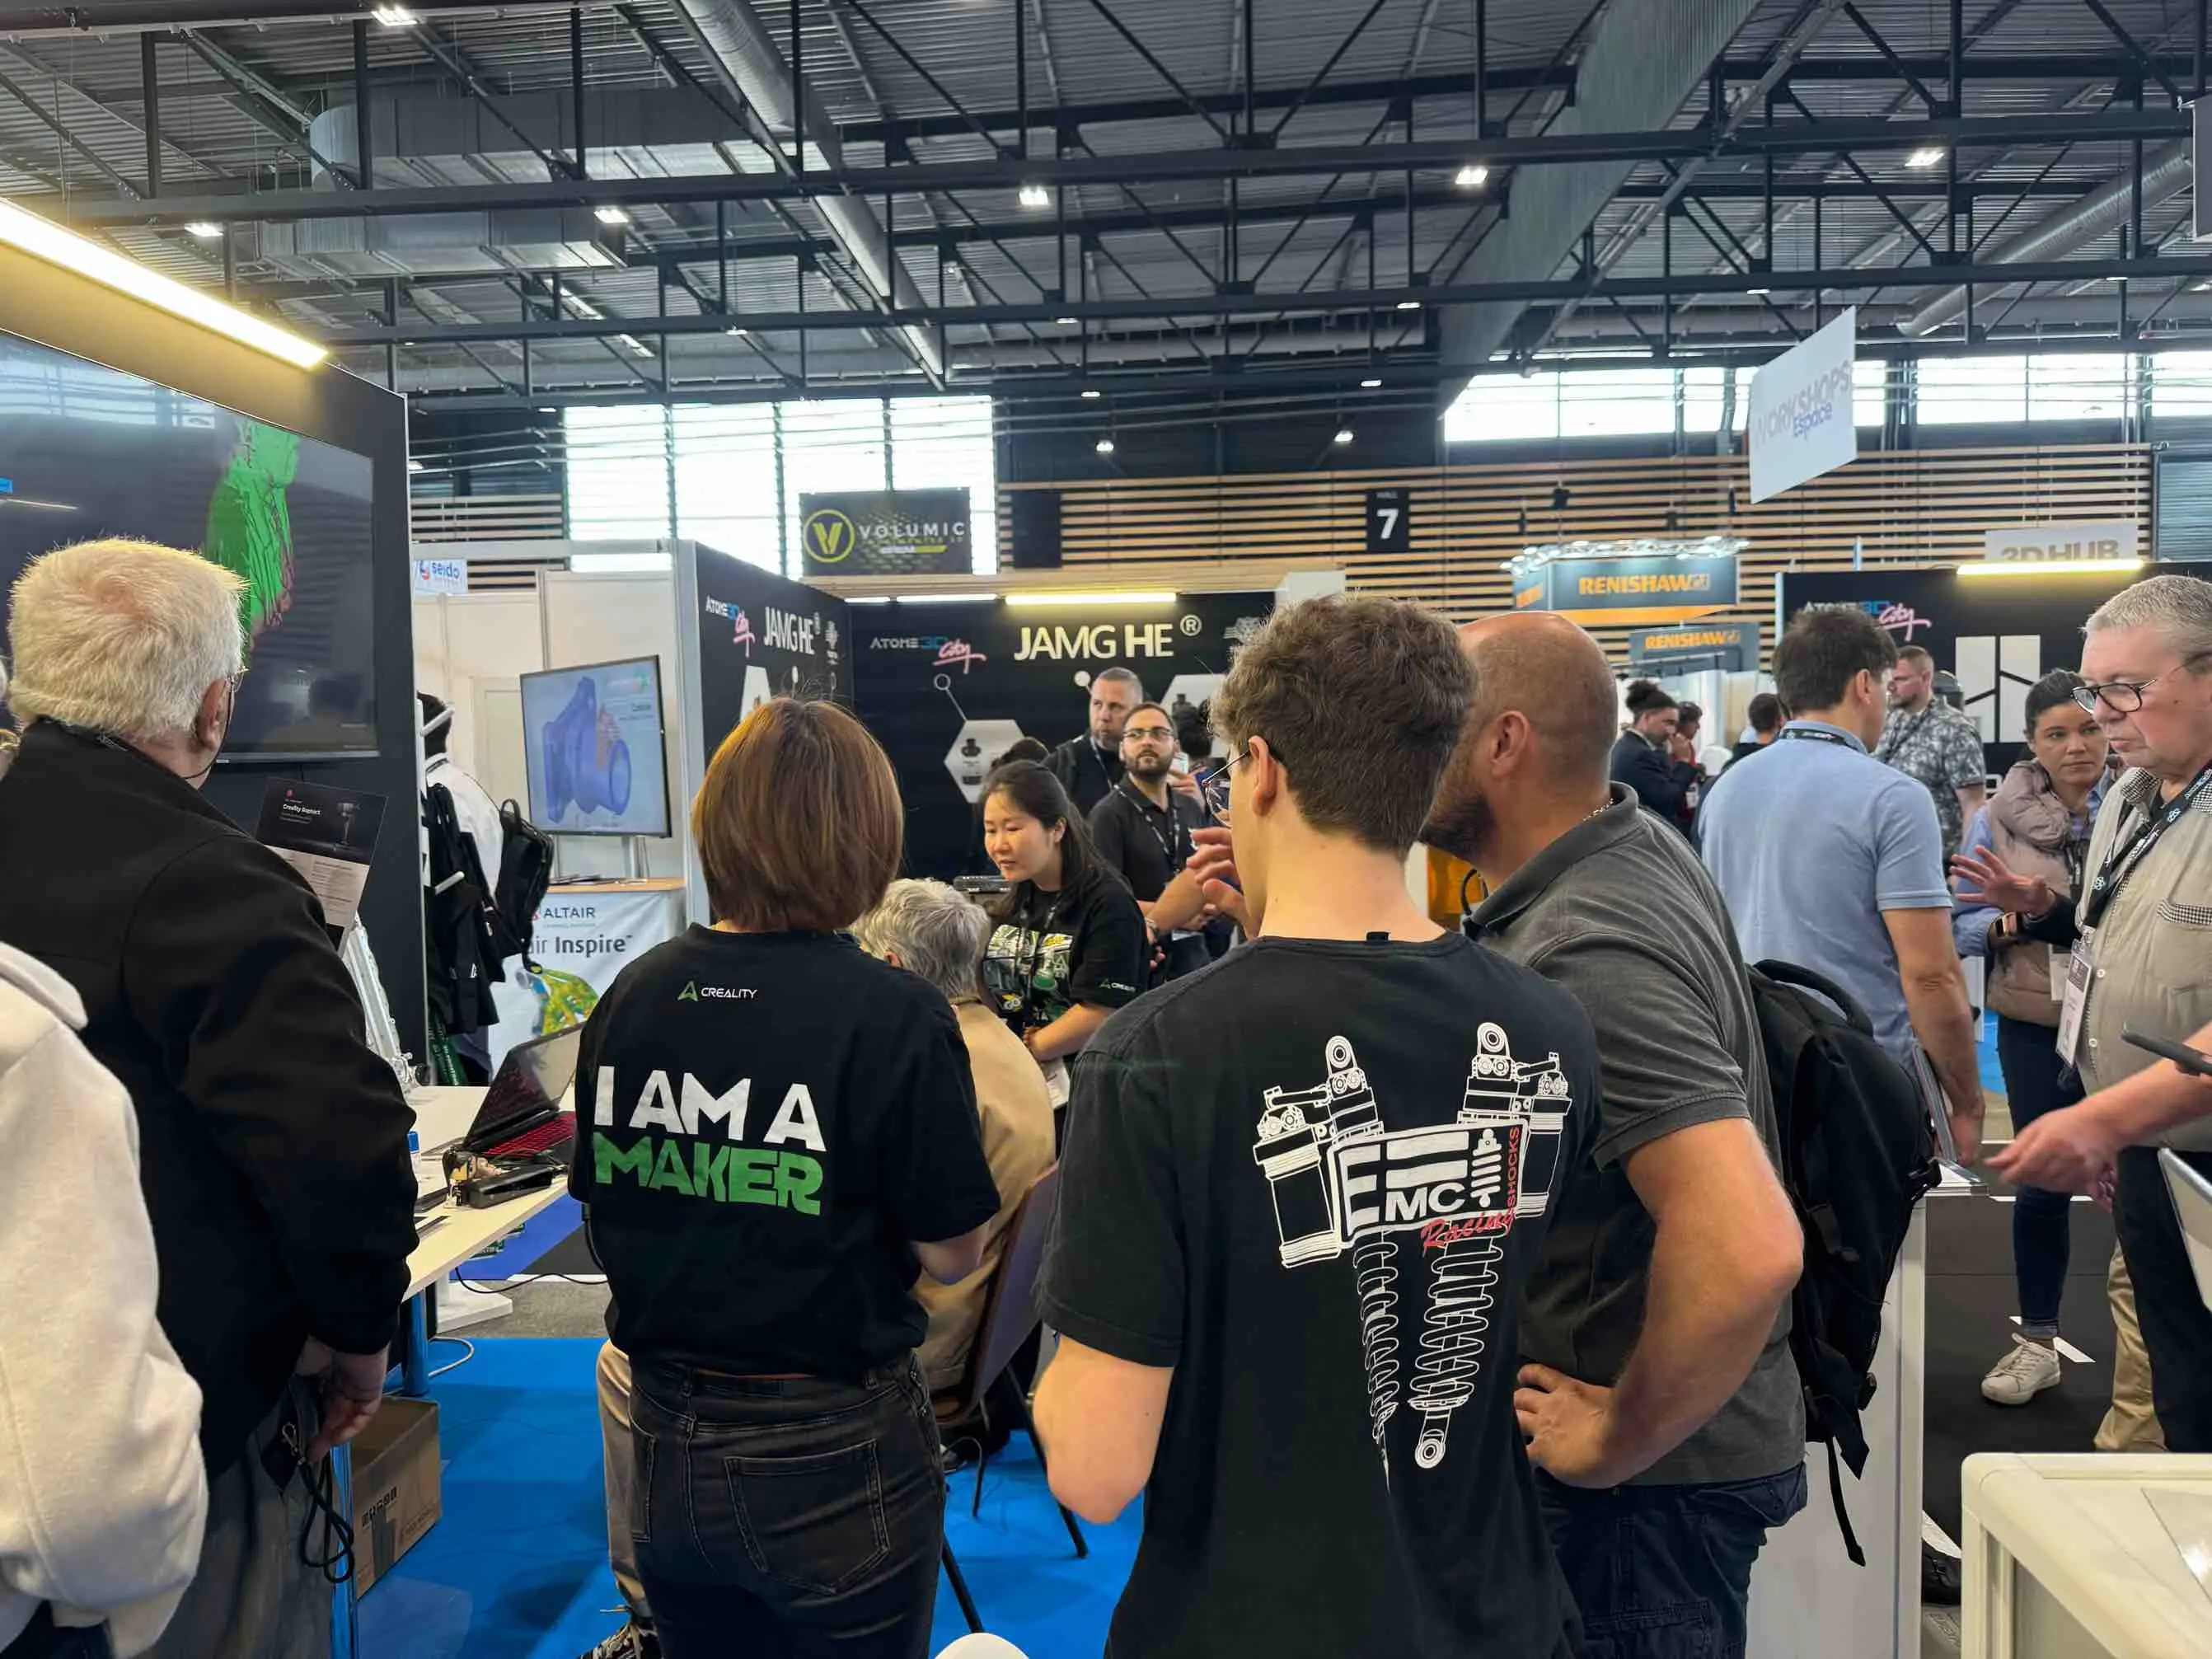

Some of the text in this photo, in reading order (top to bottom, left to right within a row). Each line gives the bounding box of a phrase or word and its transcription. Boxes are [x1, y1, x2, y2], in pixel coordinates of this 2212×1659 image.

[1752, 359, 1849, 448] WORKSHOPS
[1794, 402, 1832, 439] Espace
[859, 522, 964, 538] VOLUMIC
[1376, 508, 1399, 540] 7
[1578, 574, 1692, 595] RENISHAW
[1645, 631, 1725, 650] RENISHAW
[543, 907, 595, 919] ALTAIR
[701, 987, 757, 999] CREALITY
[594, 1066, 827, 1152] I AM A
[593, 1132, 823, 1216] MAKER
[1507, 1127, 1521, 1207] SHOCKS
